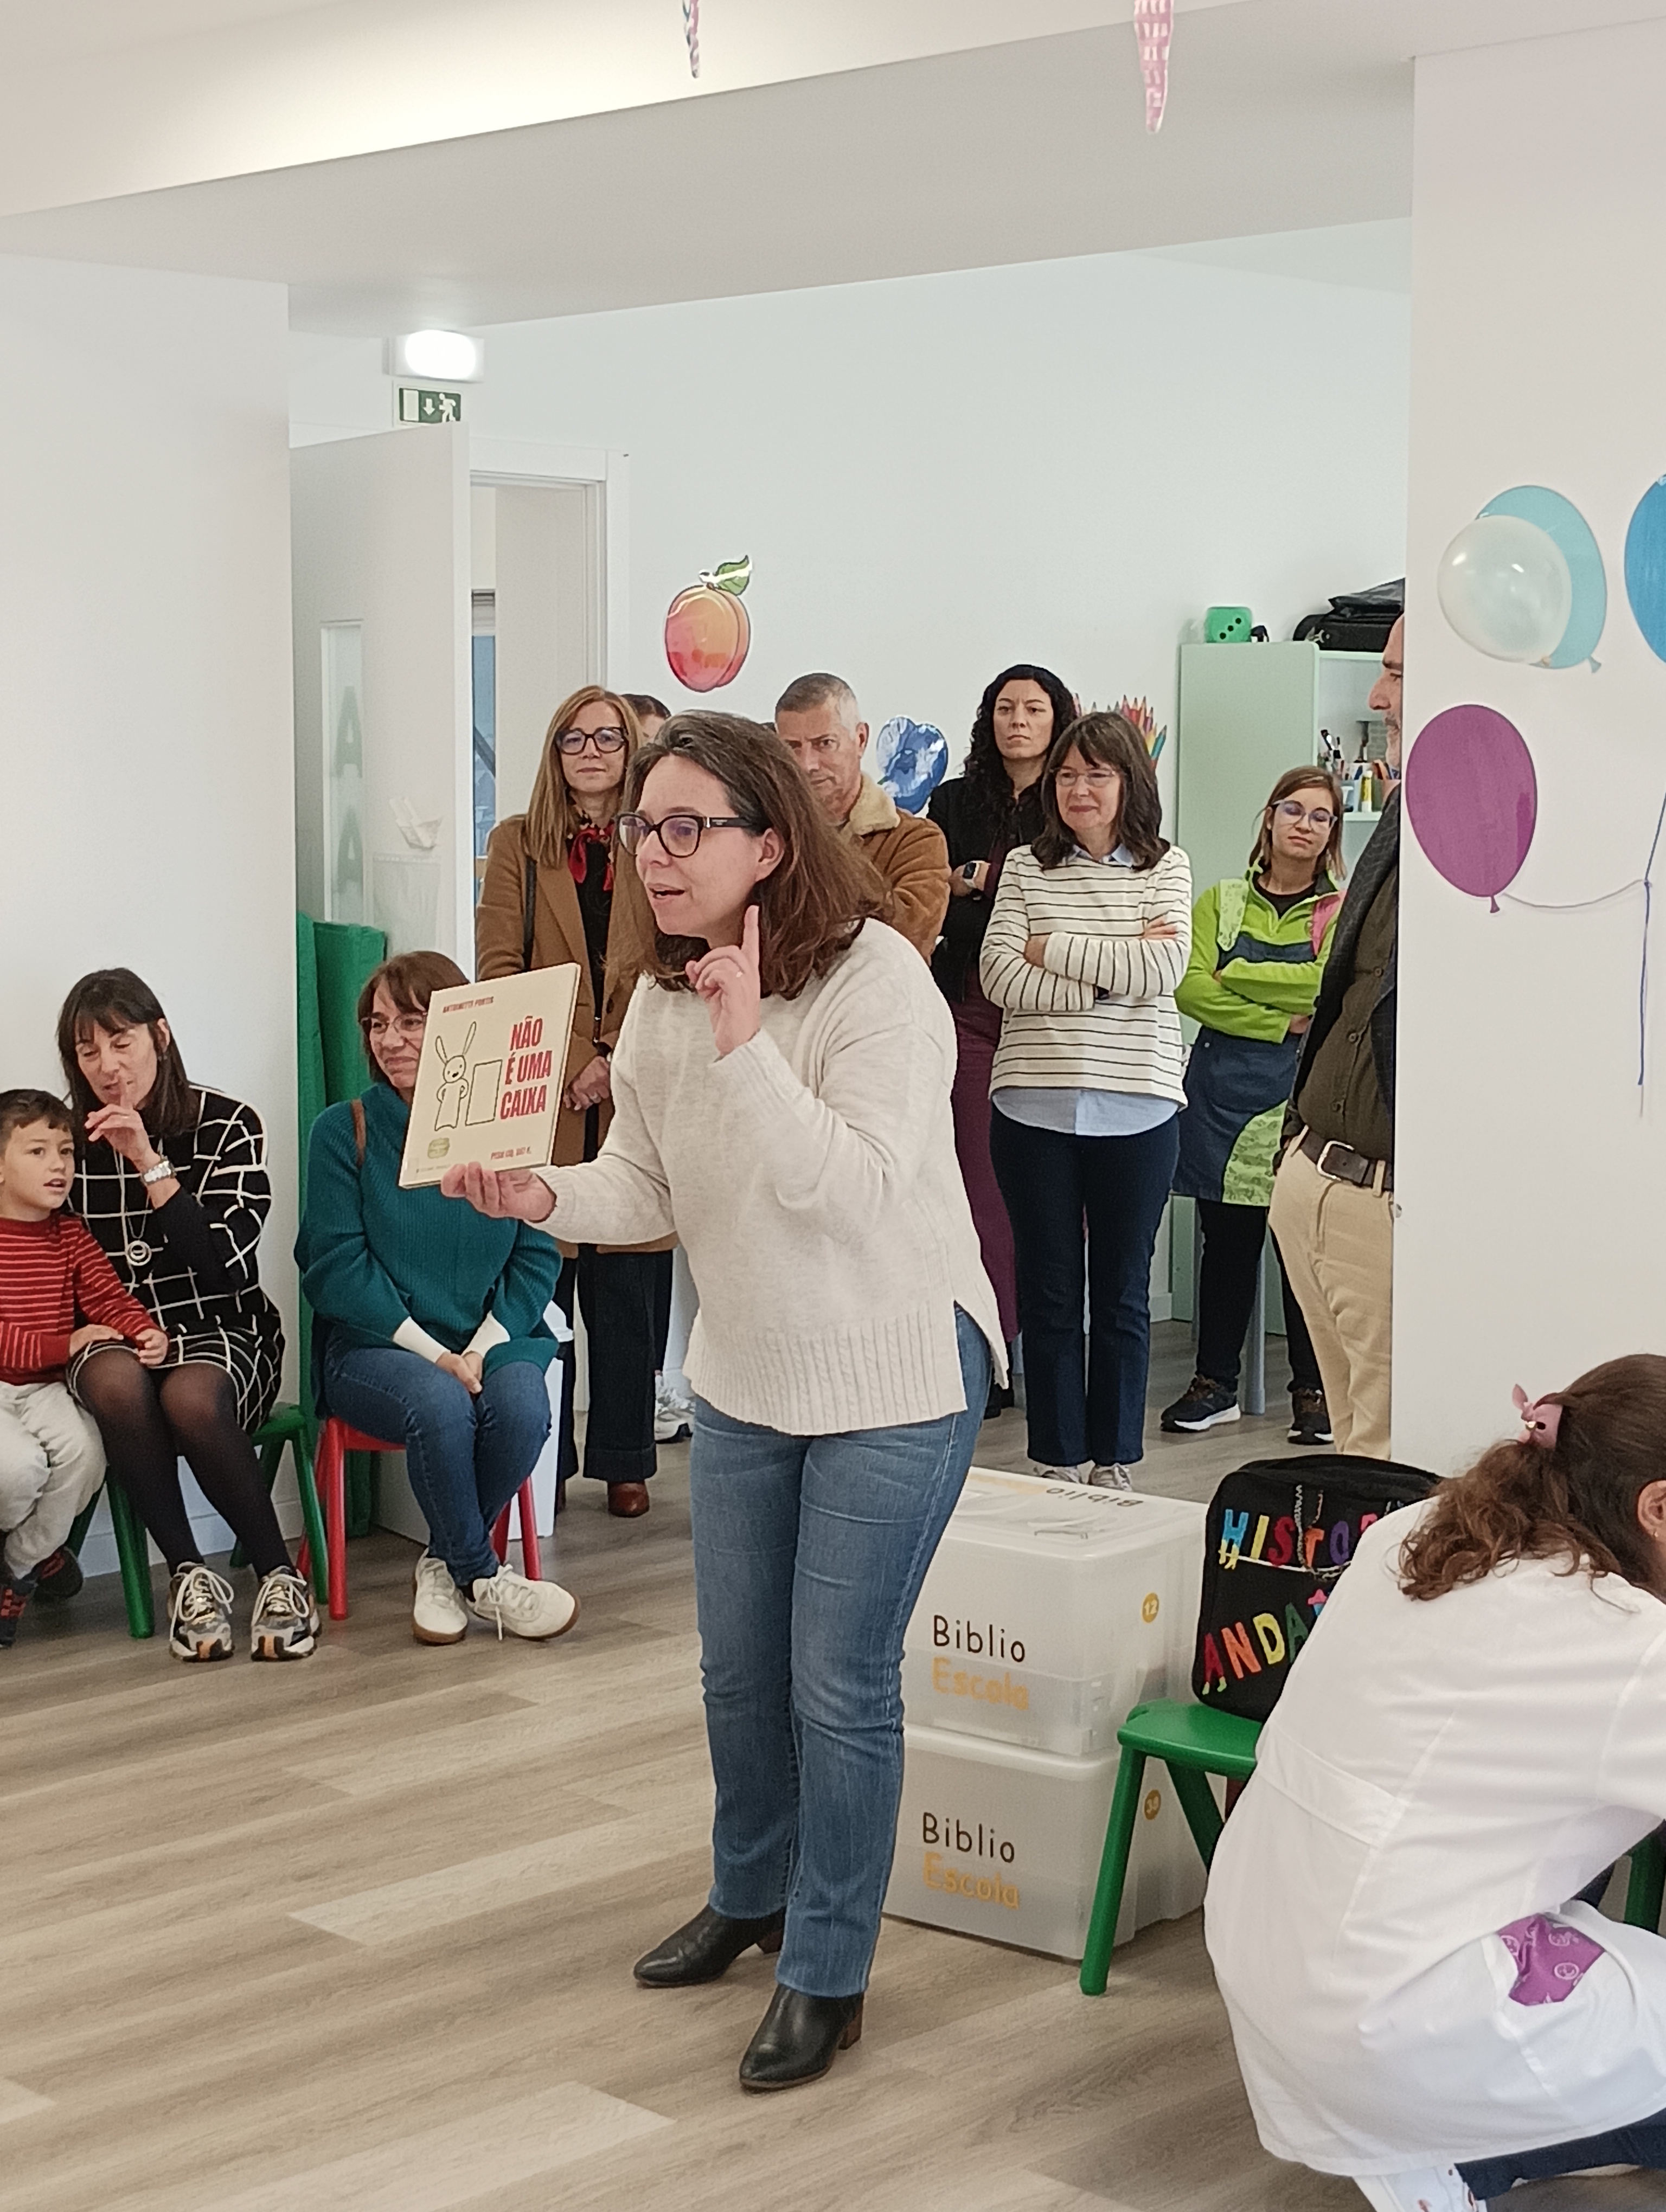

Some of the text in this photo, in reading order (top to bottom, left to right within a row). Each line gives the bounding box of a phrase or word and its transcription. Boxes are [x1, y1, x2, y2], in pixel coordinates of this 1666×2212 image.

[510, 1015, 543, 1051] NÃO
[505, 1050, 553, 1085] É UMA
[500, 1084, 547, 1120] CAIXA
[1046, 1487, 1144, 1507] Biblio
[1144, 1599, 1158, 1616] 12
[933, 1615, 1026, 1663] Biblio
[932, 1657, 1029, 1711] Escola
[922, 1812, 1015, 1863] Biblio
[924, 1851, 1020, 1910] Escola
